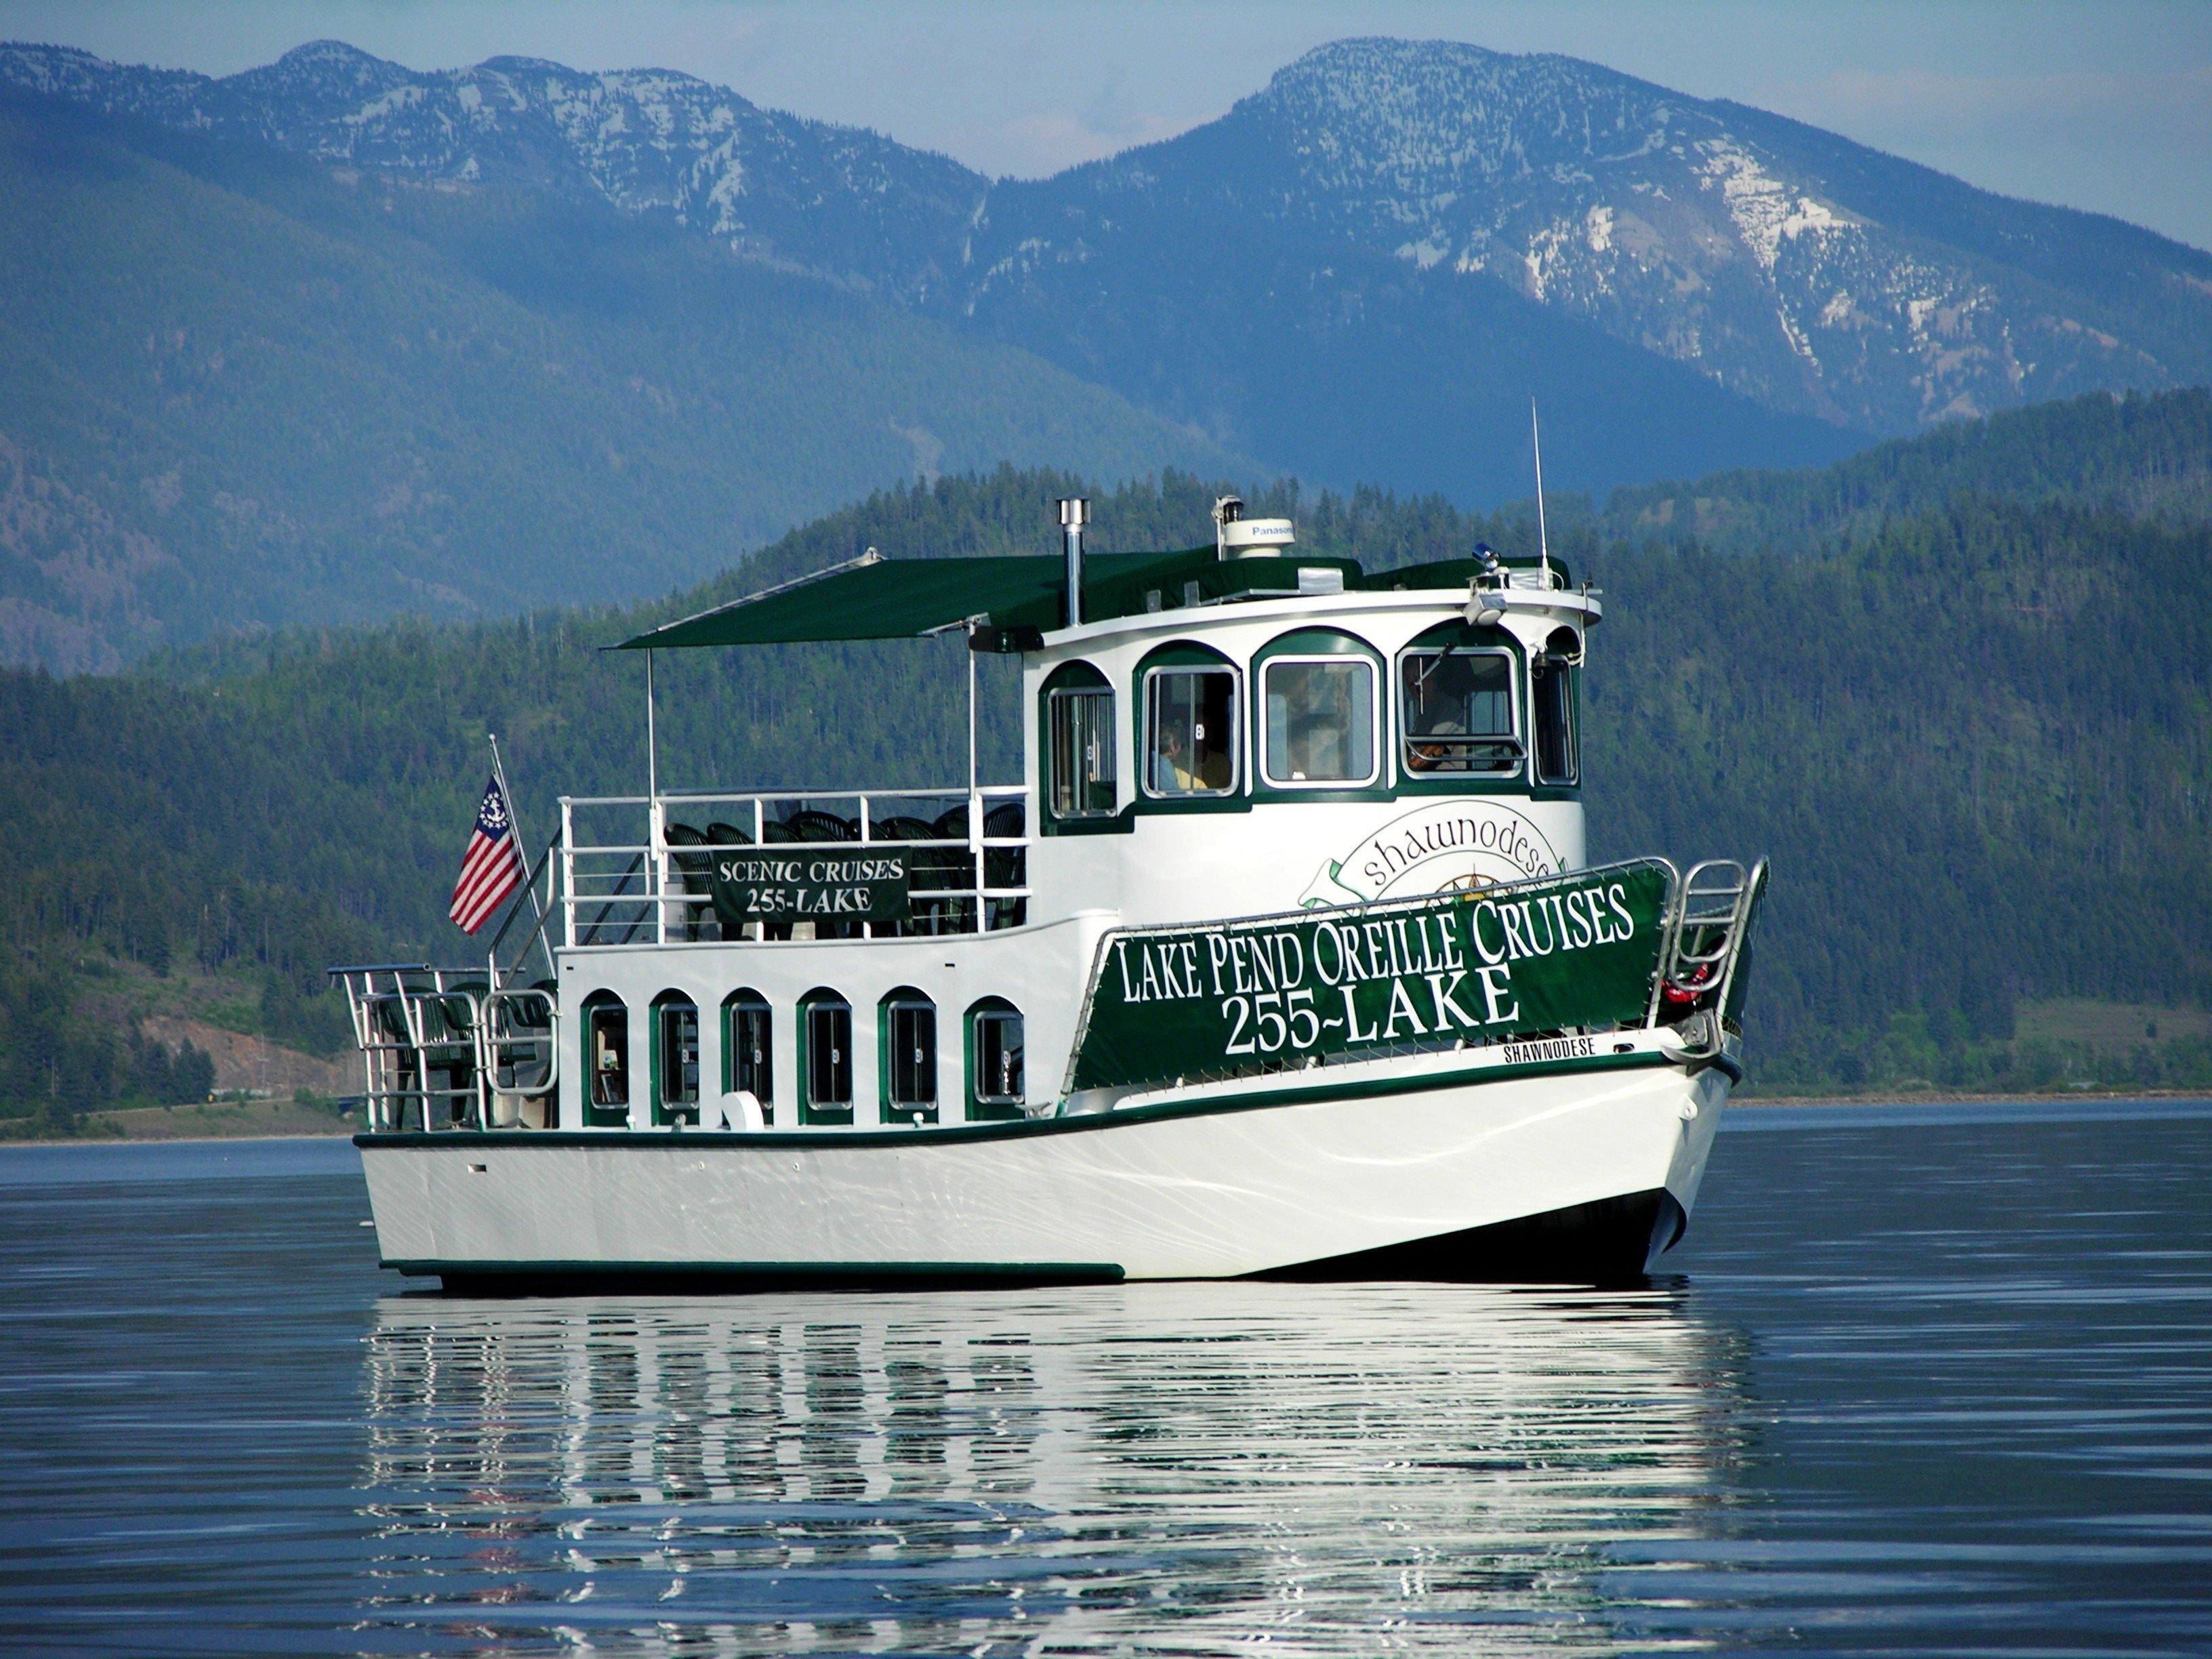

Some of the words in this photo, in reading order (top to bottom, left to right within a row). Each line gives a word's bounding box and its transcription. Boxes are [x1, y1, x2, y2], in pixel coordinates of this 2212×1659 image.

[720, 861, 802, 882] SCENIC
[809, 859, 904, 882] CRUISES
[746, 887, 872, 914] 255-LAKE
[1116, 941, 1202, 1004] LAKE
[1205, 932, 1304, 996] PEND
[1313, 912, 1464, 986] OREILLE
[1472, 883, 1635, 965] CRUISES
[1503, 1038, 1596, 1064] SHAWNODESE
